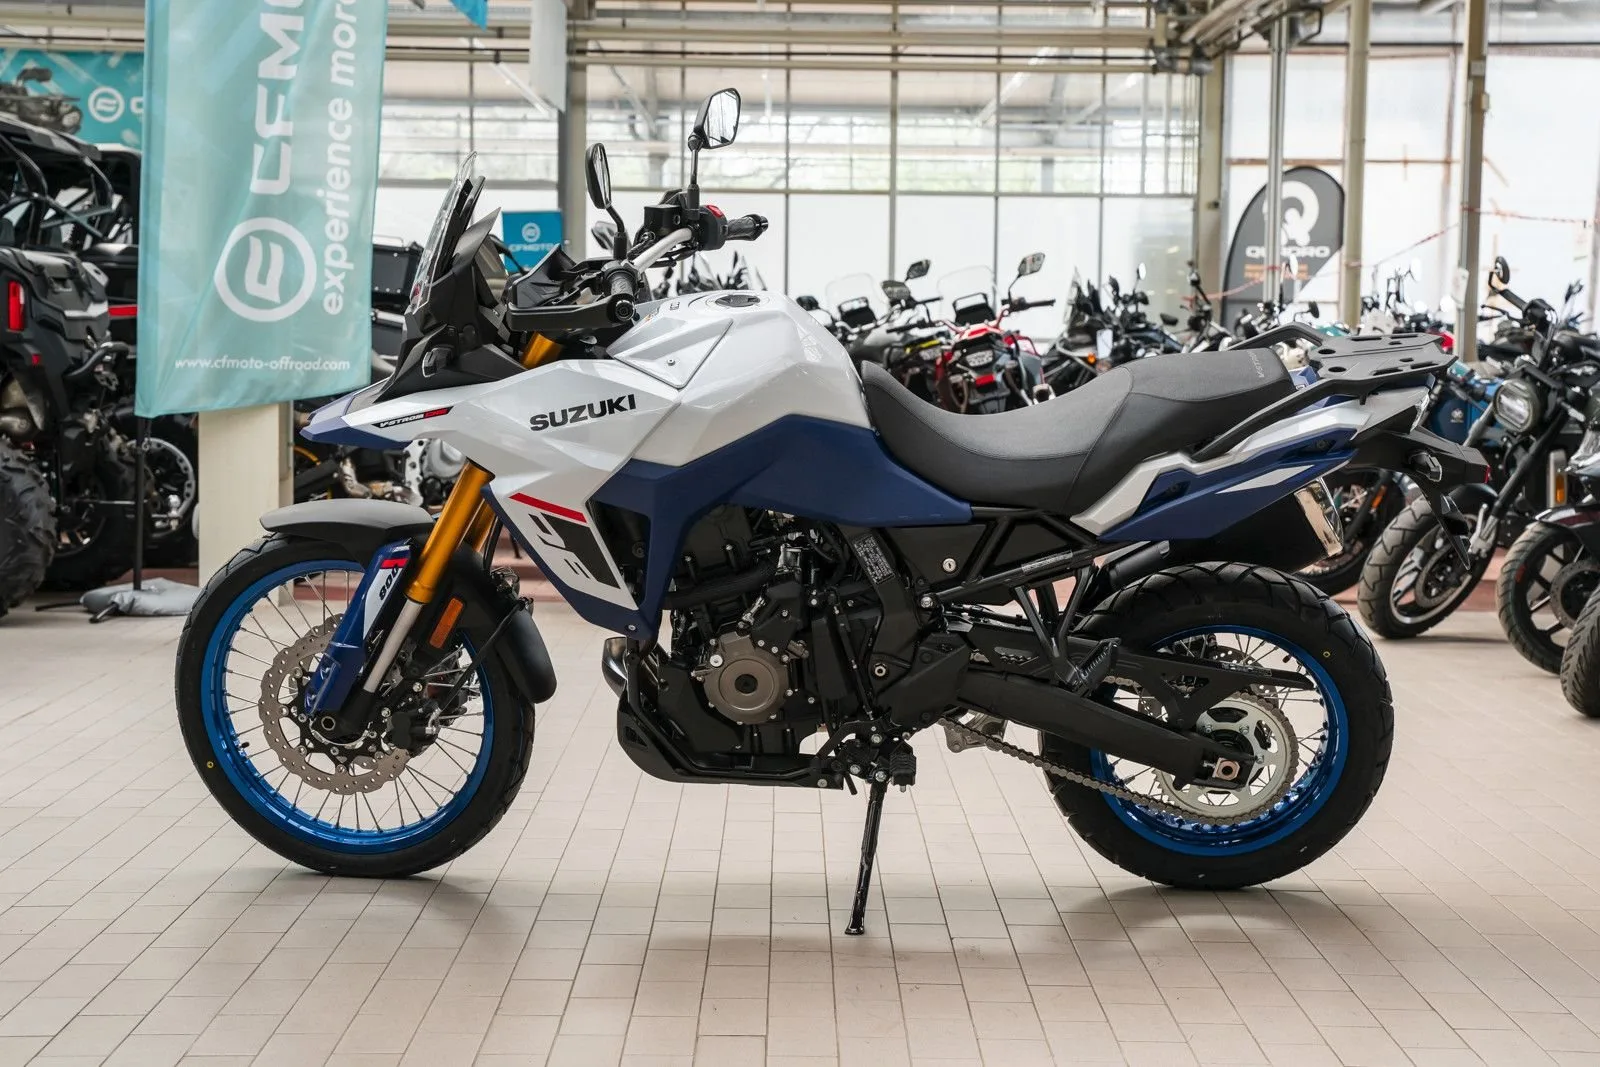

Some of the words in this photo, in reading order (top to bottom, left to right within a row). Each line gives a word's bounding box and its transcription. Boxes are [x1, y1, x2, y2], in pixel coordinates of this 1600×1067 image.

[330, 0, 357, 88] mor
[250, 0, 304, 195] CFM
[316, 97, 355, 315] experience
[175, 354, 350, 371] www.cfmoto-offroad.com
[530, 394, 636, 431] SUZUKI
[379, 564, 399, 600] 800
